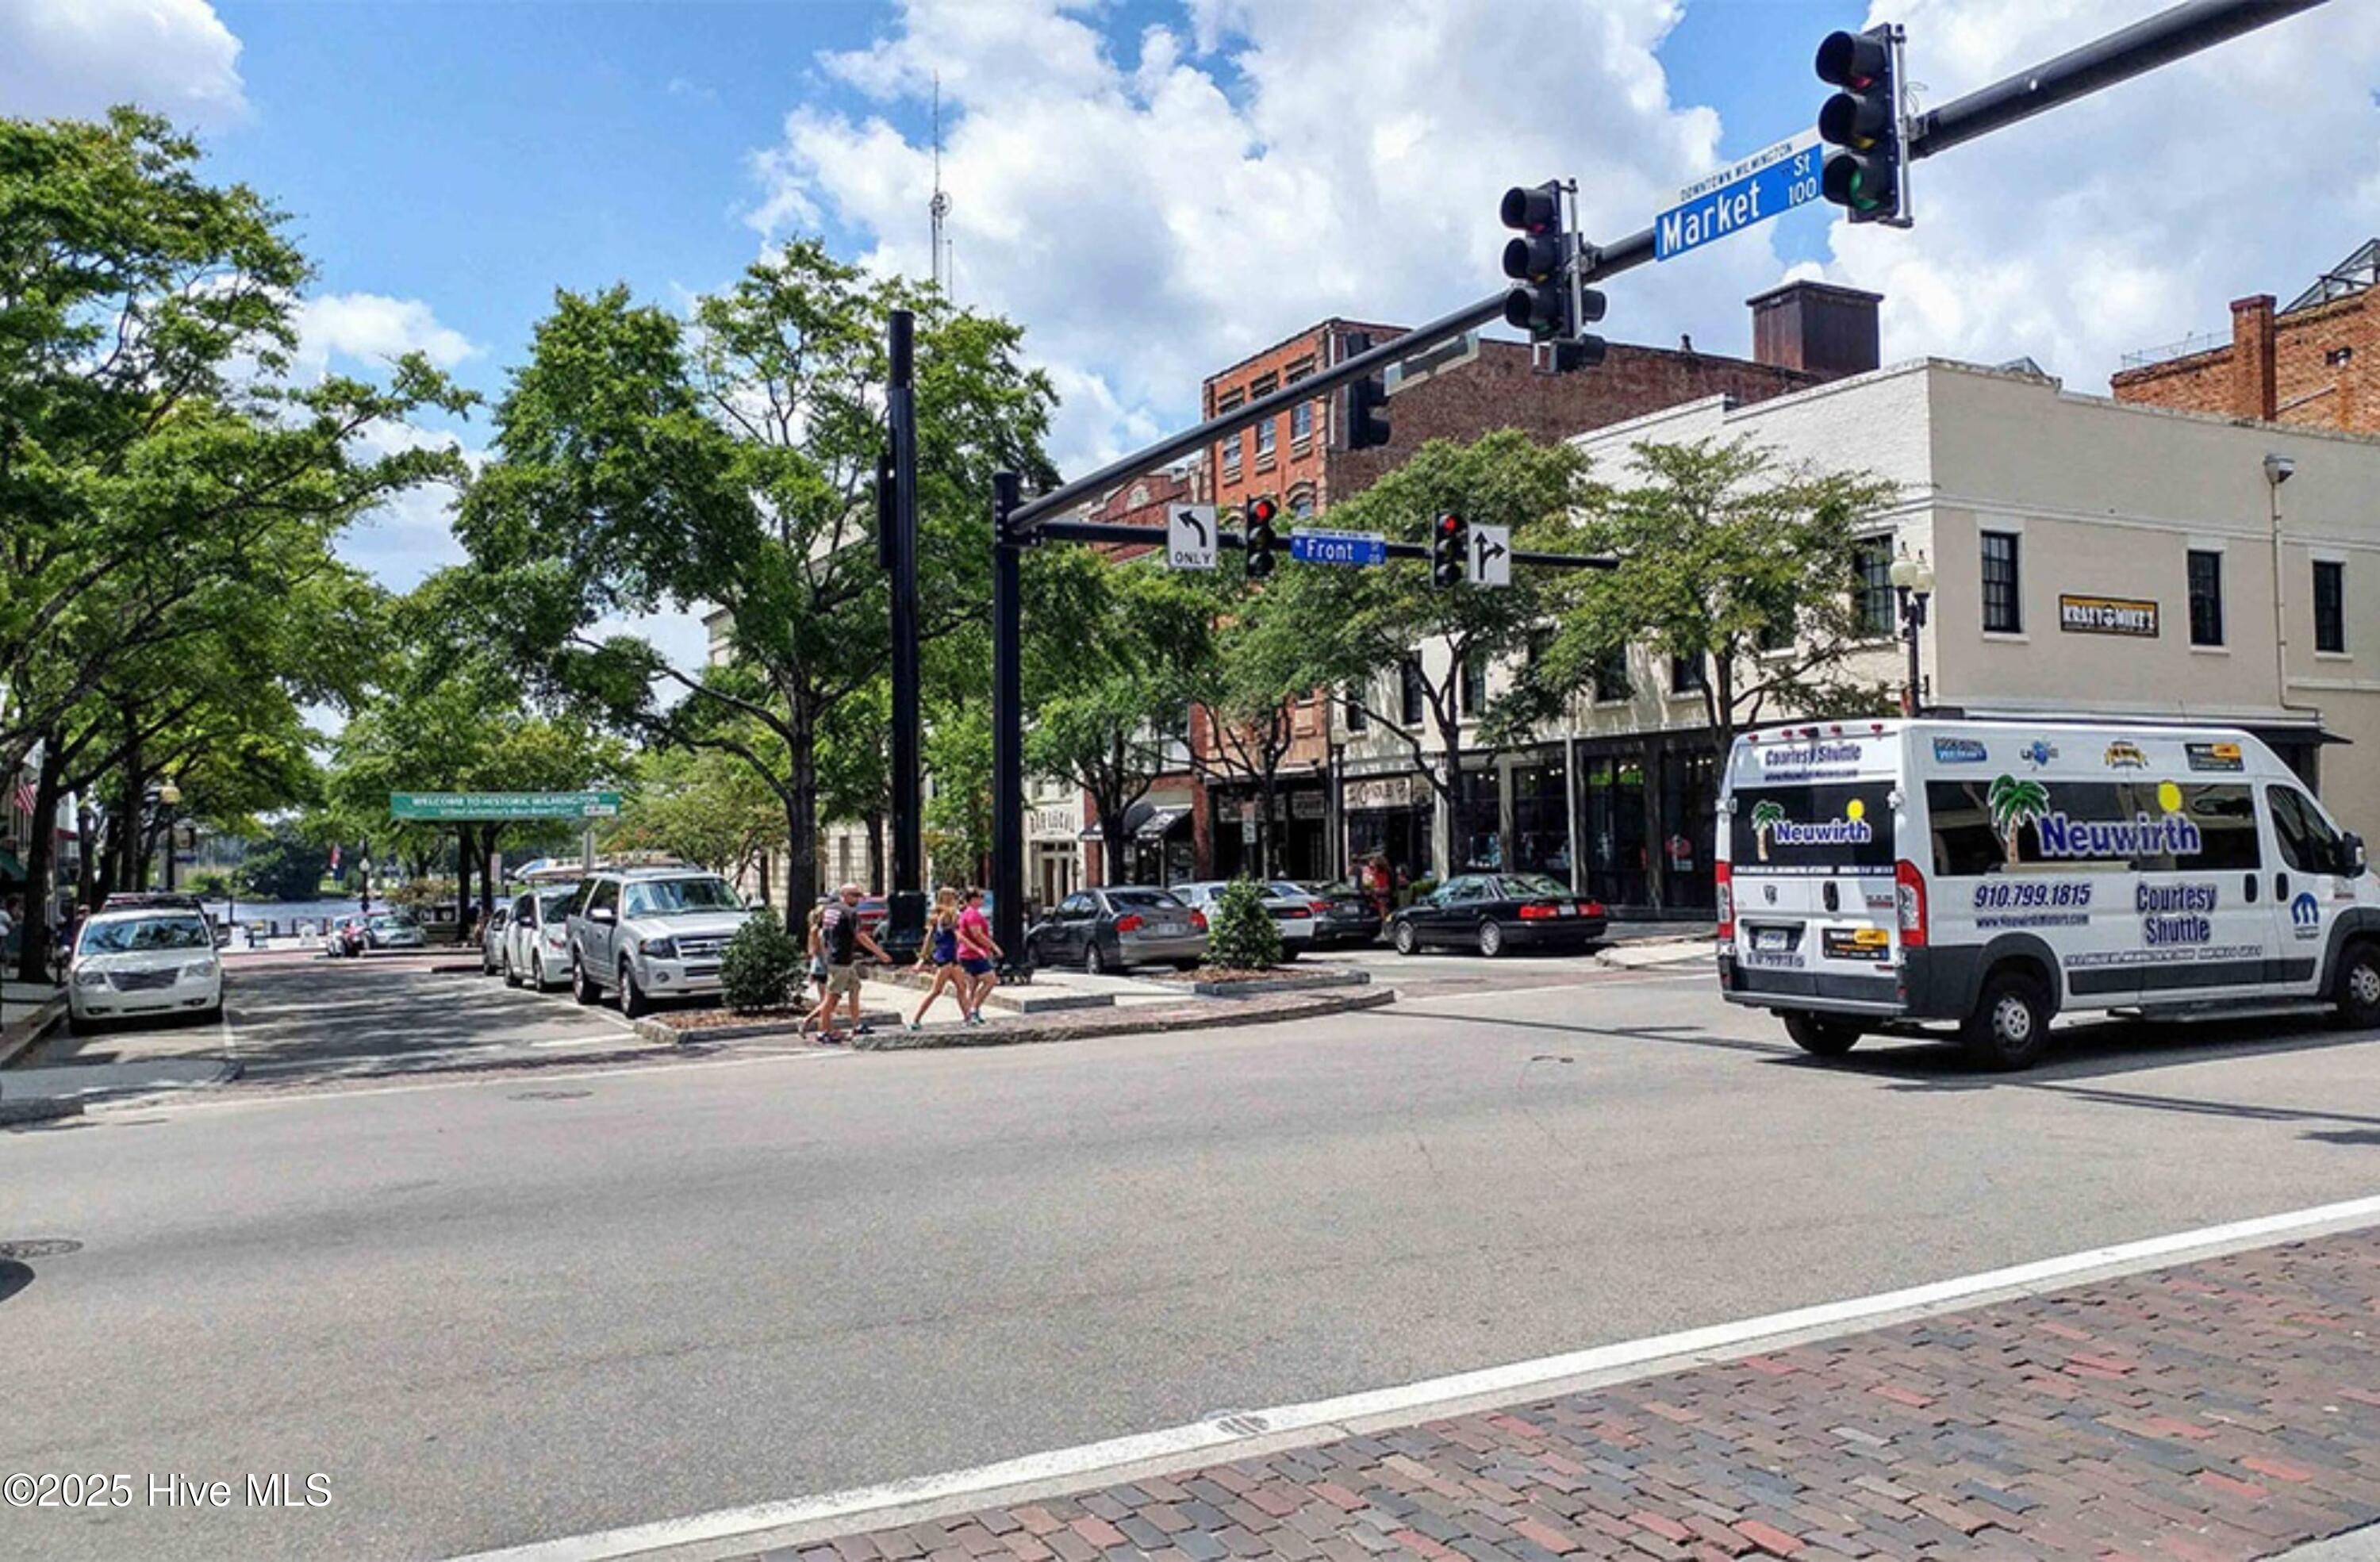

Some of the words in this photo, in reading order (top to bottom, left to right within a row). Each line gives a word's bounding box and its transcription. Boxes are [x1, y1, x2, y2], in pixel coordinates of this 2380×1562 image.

[1662, 179, 1760, 255] Market
[1793, 155, 1810, 176] St
[1788, 177, 1817, 208] 100
[1175, 551, 1211, 564] ONLY
[1306, 539, 1354, 561] Front
[1764, 747, 1816, 767] Courtesy
[1818, 743, 1862, 762] Shuttle
[411, 796, 464, 807] WELCOME
[466, 796, 480, 807] TO
[1775, 819, 1871, 842] Neuwirth
[2040, 814, 2201, 854] Neuwirth
[1974, 883, 2091, 908] 910.799.1815
[2136, 883, 2217, 915] Courtesy
[2145, 915, 2211, 944] Shuttle
